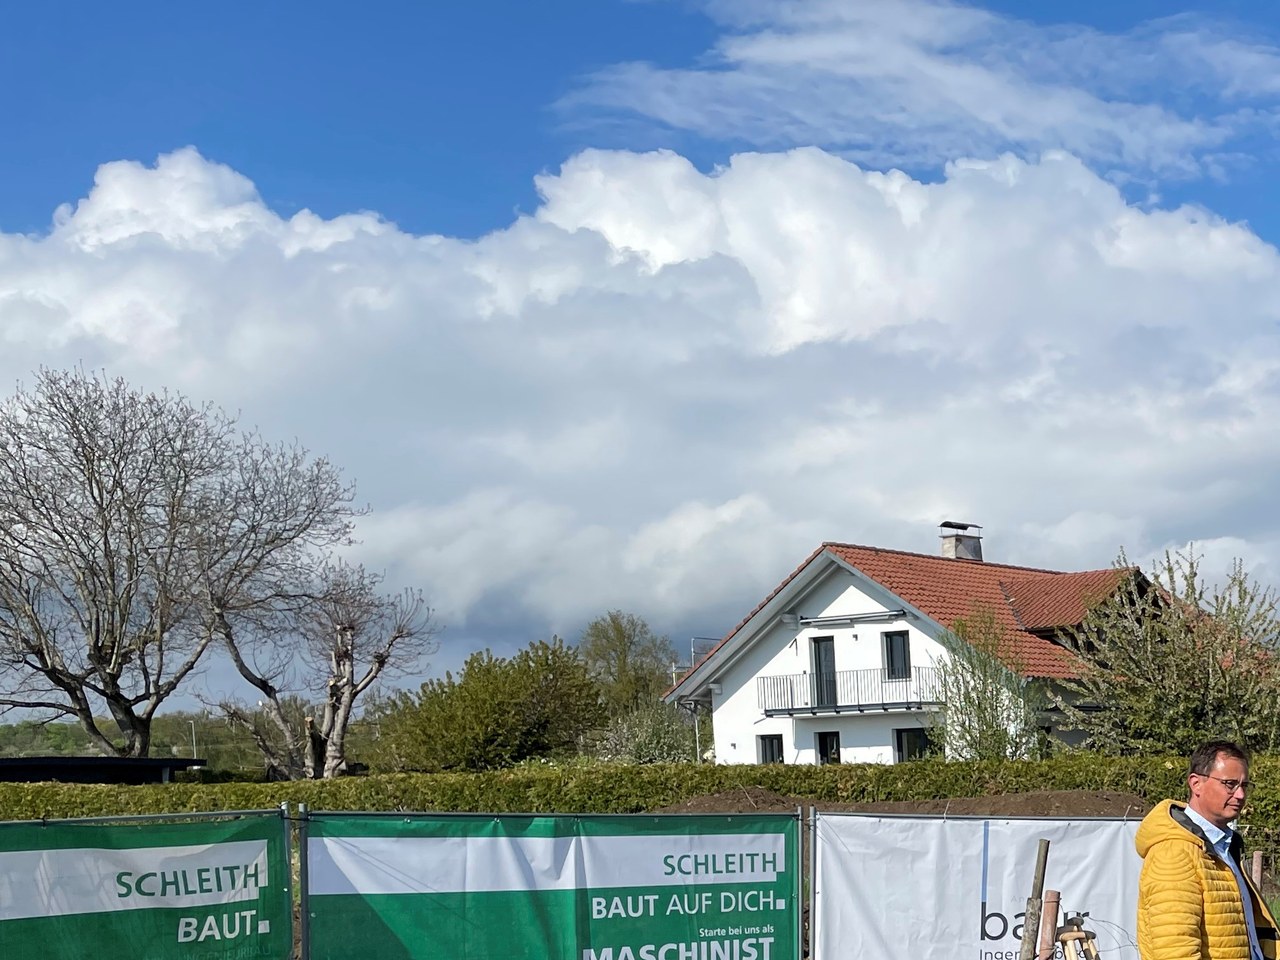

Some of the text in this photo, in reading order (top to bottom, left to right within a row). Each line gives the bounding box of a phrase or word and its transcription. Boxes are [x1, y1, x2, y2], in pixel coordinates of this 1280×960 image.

[662, 852, 777, 877] SCHLEITH
[116, 862, 260, 898] SCHLEITH
[592, 895, 660, 920] BAUT
[665, 893, 712, 916] AUF
[699, 924, 775, 938] Starte bei uns als
